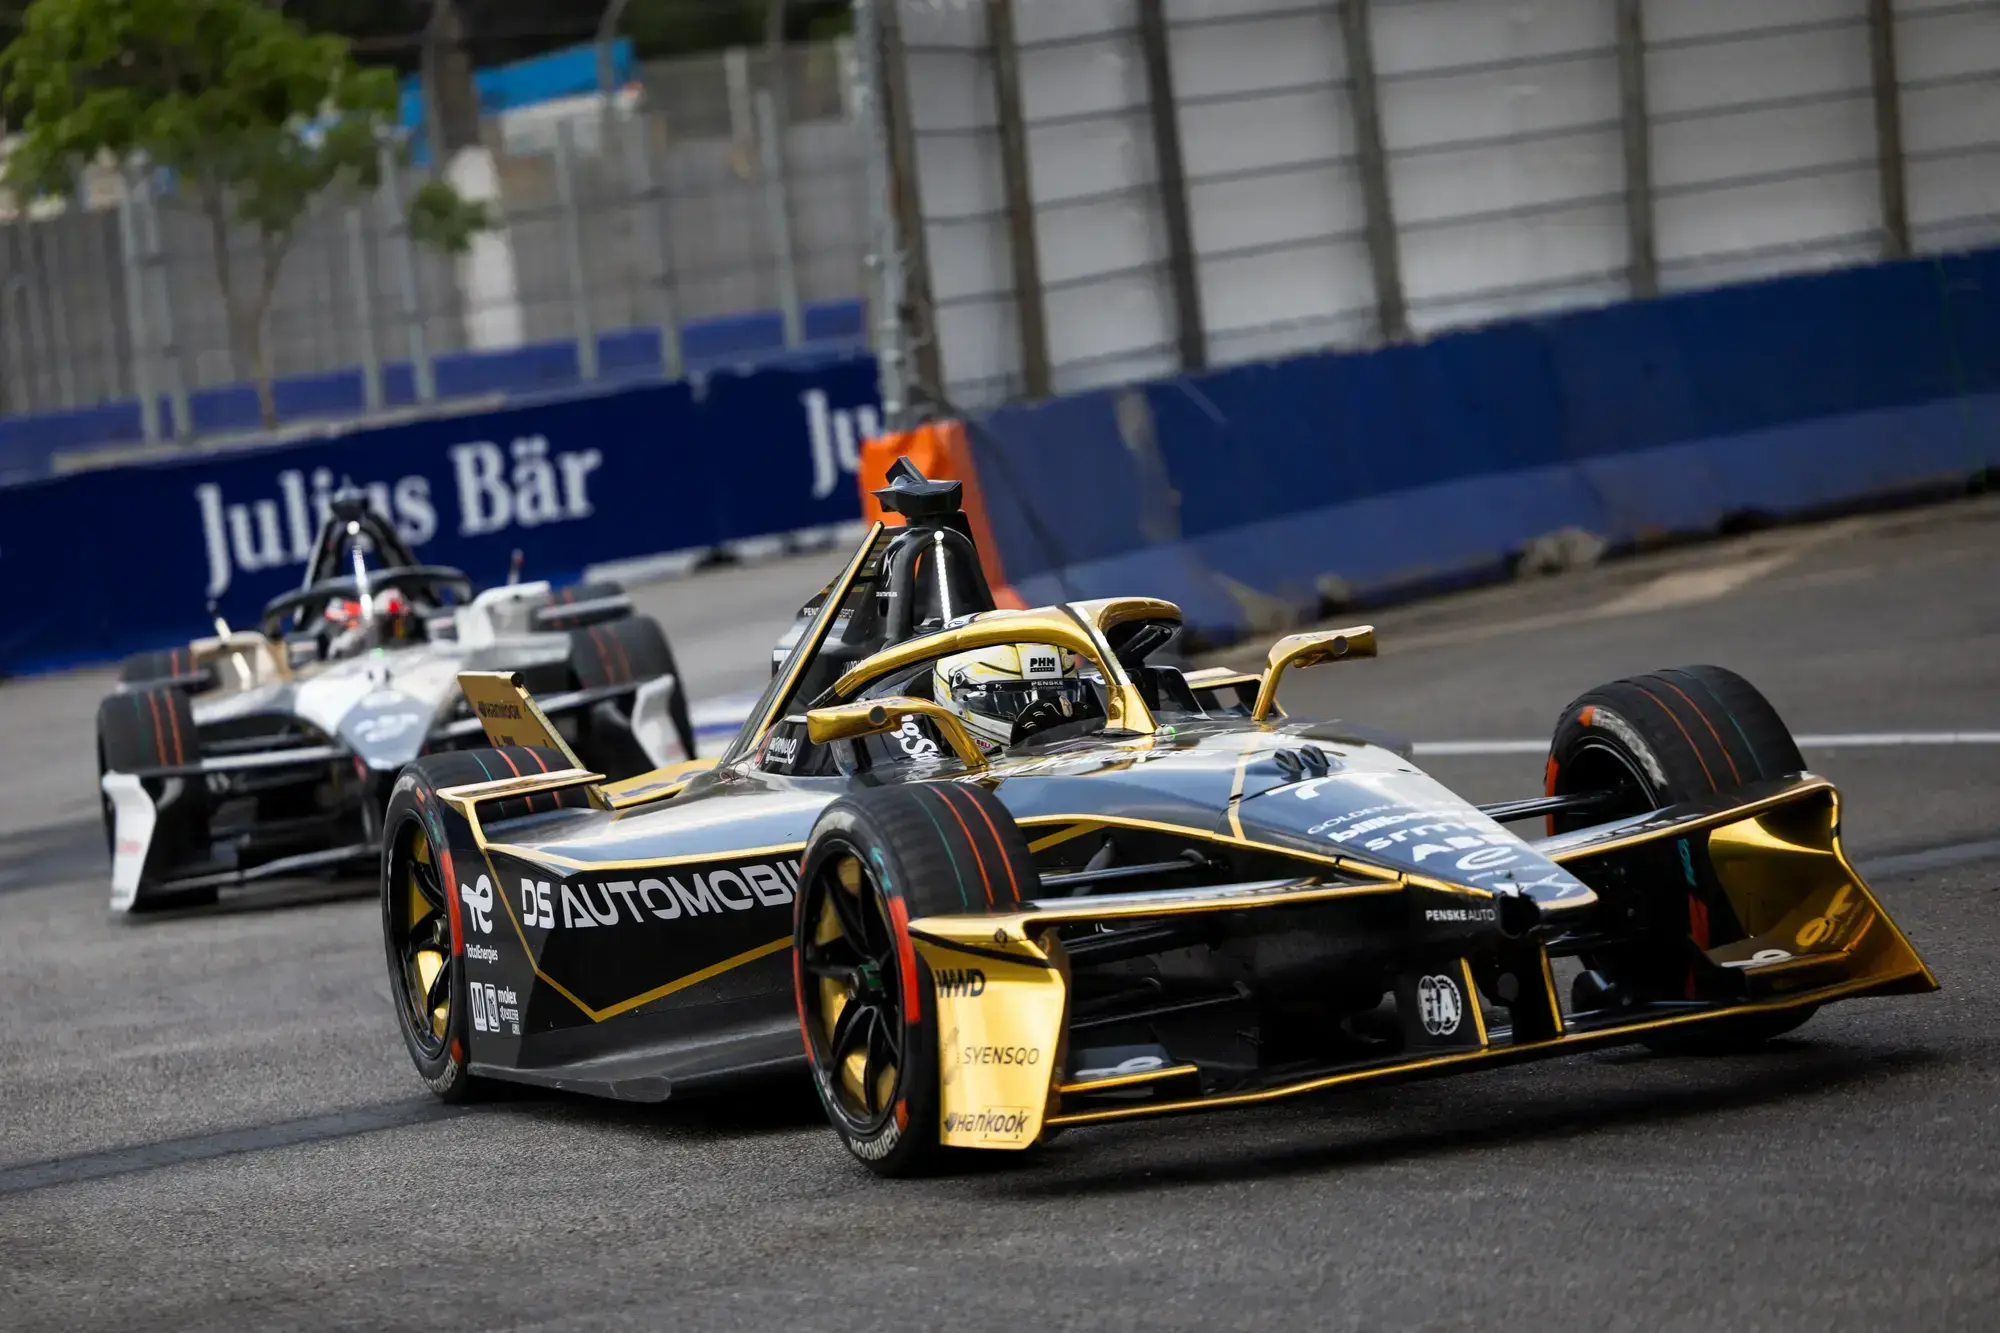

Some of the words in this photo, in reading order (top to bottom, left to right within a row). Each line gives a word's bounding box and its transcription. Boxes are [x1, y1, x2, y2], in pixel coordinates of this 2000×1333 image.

[450, 434, 602, 535] Bär
[1030, 657, 1055, 667] PHM
[520, 878, 554, 929] DS
[1425, 909, 1467, 921] PENSKE
[466, 943, 498, 964] TotalEnergies
[497, 986, 517, 1004] molex
[935, 968, 986, 998] WWD
[1419, 988, 1458, 1023] FIA
[963, 1046, 1040, 1066] SYENSQO
[954, 1110, 1029, 1134] Hankook
[849, 1115, 901, 1160] Hankook
